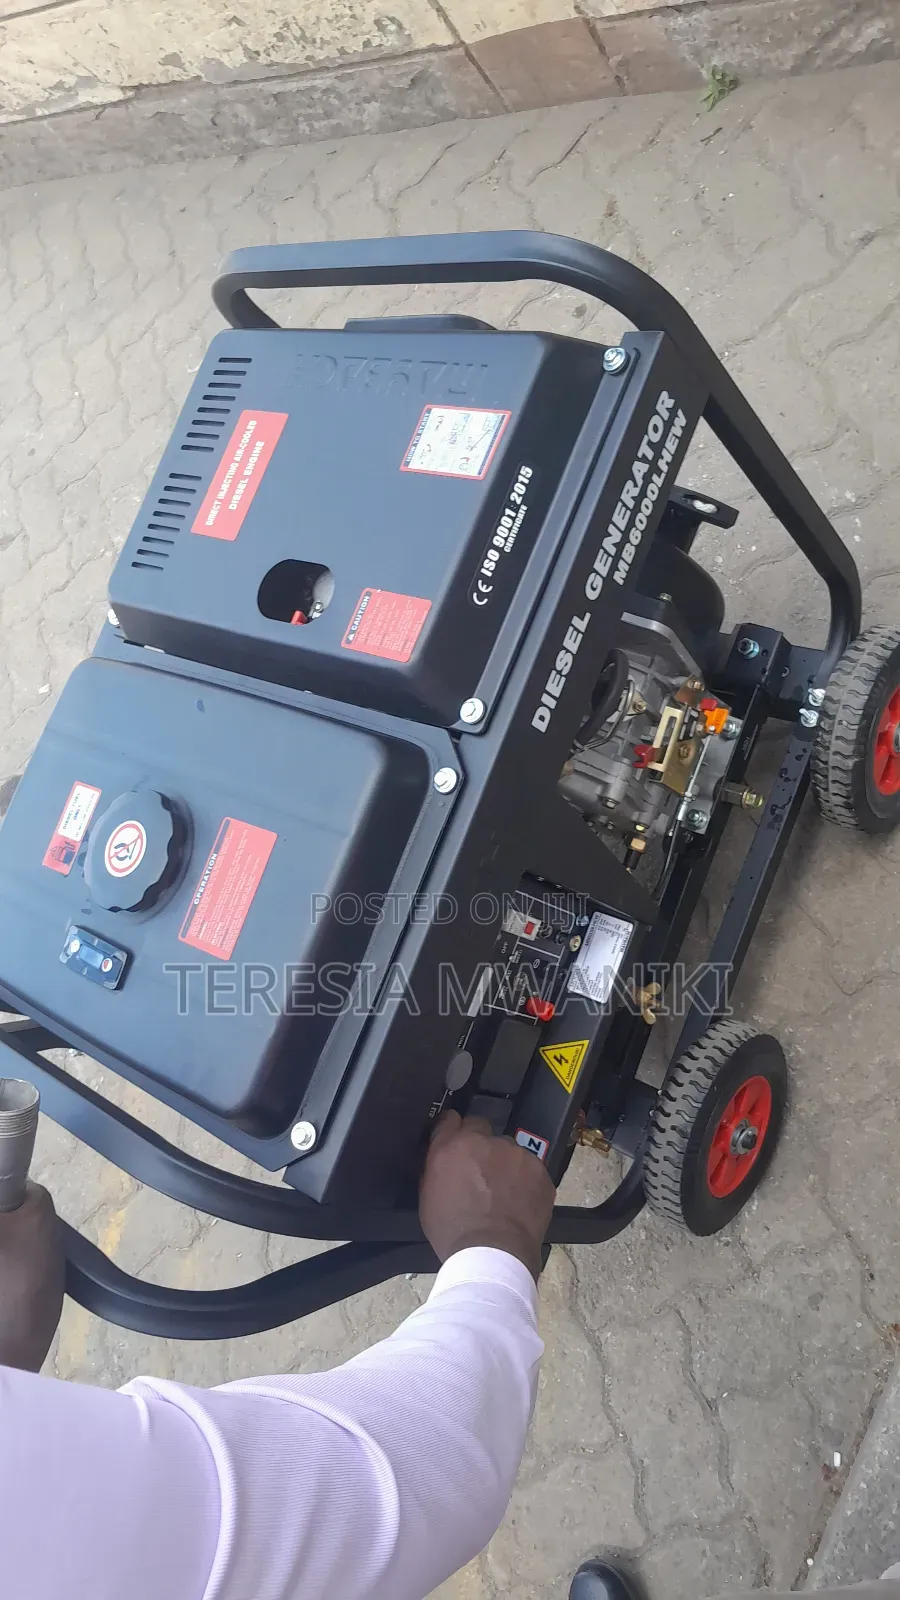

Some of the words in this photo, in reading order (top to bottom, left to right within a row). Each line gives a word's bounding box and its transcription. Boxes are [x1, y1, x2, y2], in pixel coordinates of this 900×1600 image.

[205, 499, 221, 526] DIRECT
[216, 461, 238, 500] INJECTING
[233, 419, 257, 462] AIR-COOLED
[228, 478, 249, 511] DIESEL
[243, 440, 265, 476] ENGINE
[612, 409, 687, 586] MB6000LHEW
[503, 504, 528, 553] CERTIFICATE
[480, 548, 501, 576] ISO
[531, 613, 592, 733] DIESEL
[583, 390, 676, 601] GENERATOR
[351, 594, 370, 631] CAUTION
[194, 852, 218, 905] OPERATION
